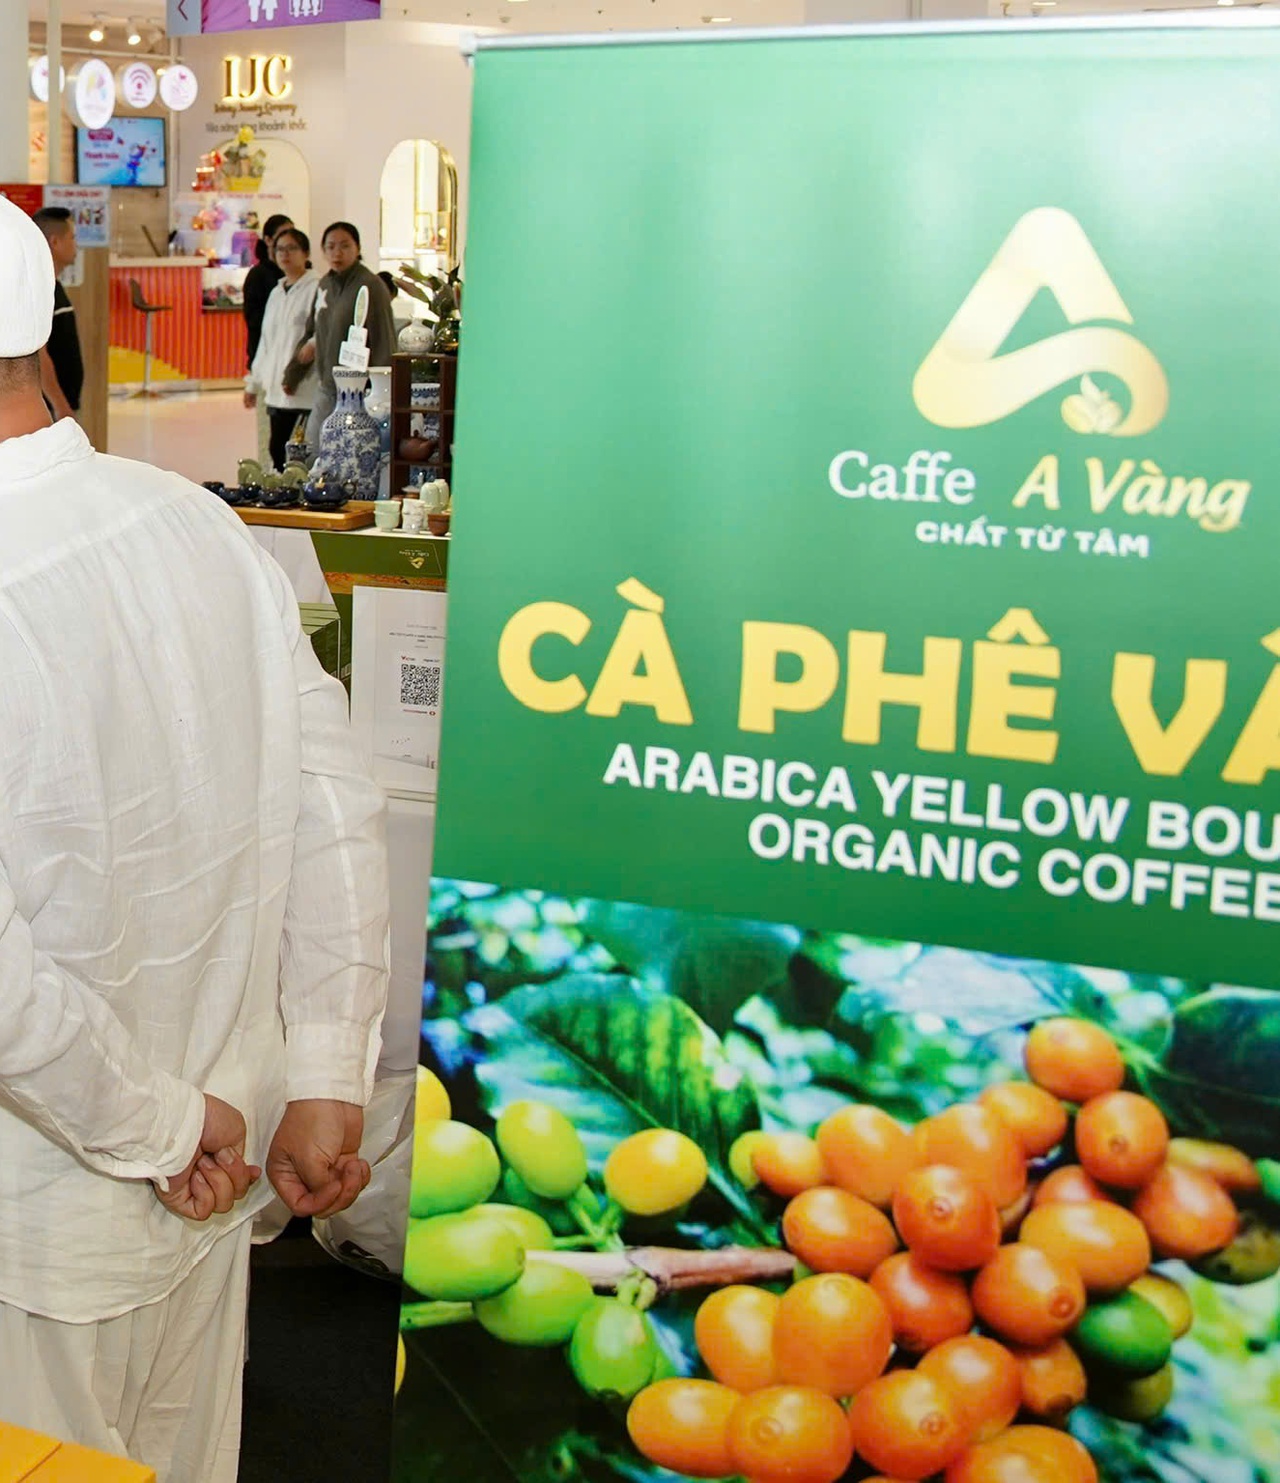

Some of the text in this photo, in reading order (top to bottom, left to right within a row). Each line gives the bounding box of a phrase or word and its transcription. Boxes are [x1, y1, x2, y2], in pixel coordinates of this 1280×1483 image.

[222, 56, 291, 100] IJC
[828, 450, 1252, 532] Caffe A Vàng
[915, 515, 1150, 558] CHẤT TỪ TÂM
[497, 576, 694, 726] CÀ
[737, 607, 1061, 764] PHÊ
[603, 742, 857, 812] ARABICA
[871, 770, 1130, 843] YELLOW
[748, 812, 1280, 923] ORGANIC COFFEE
